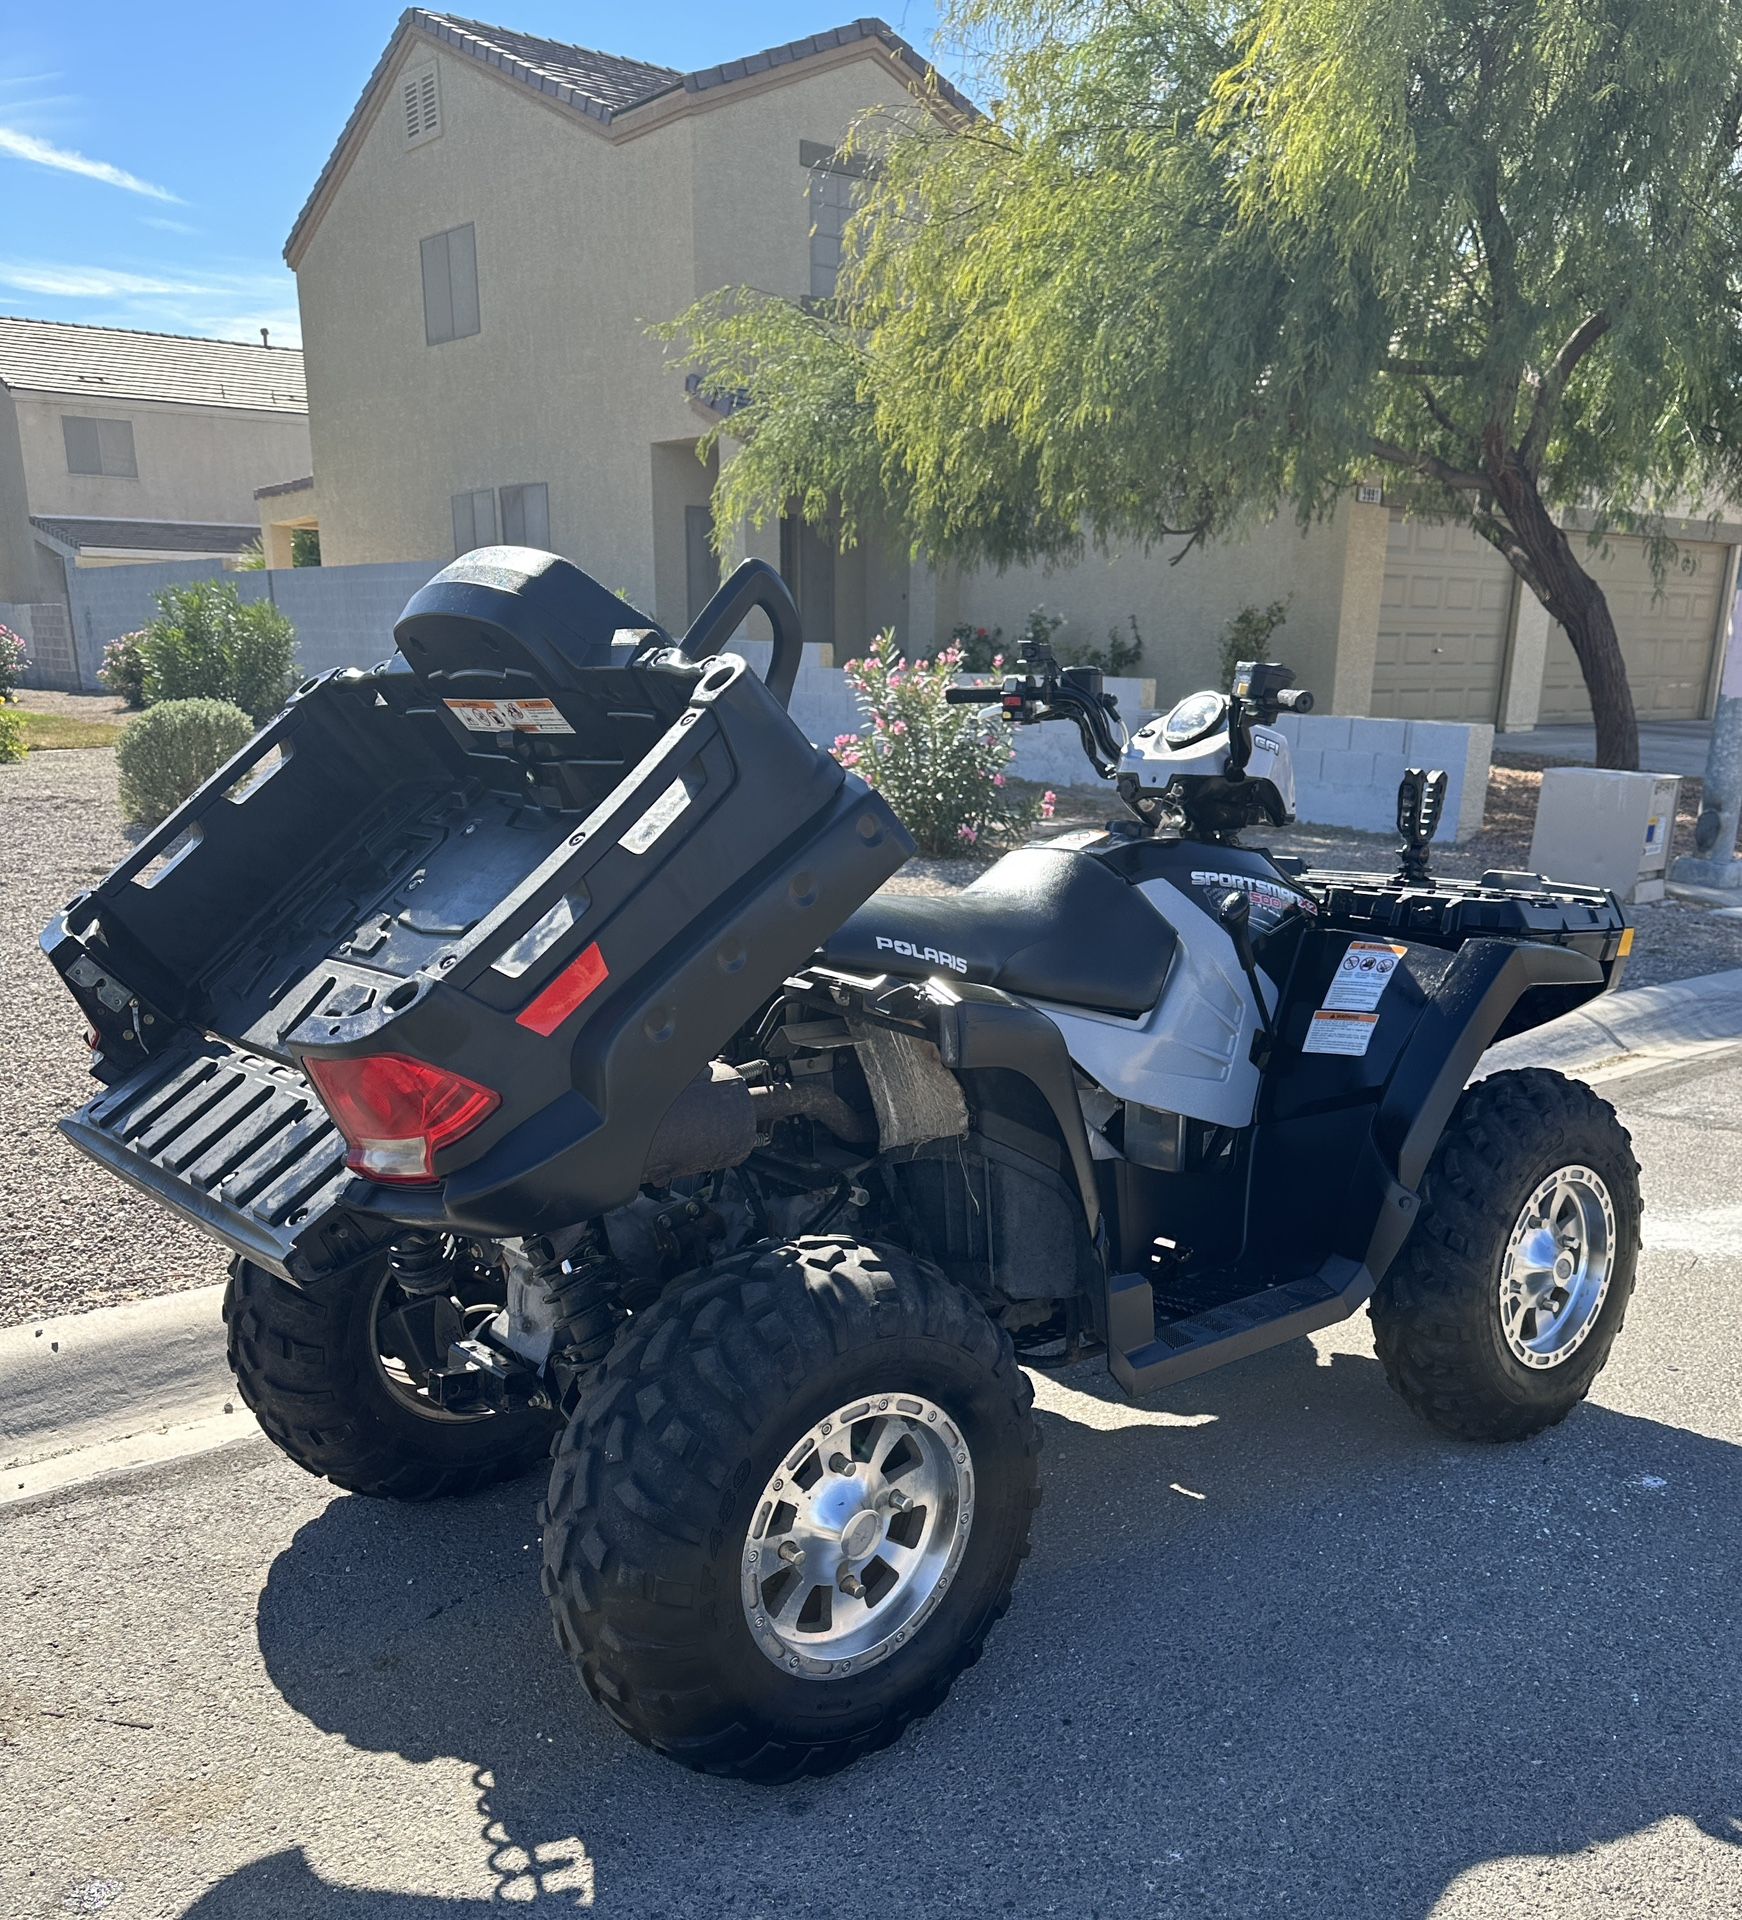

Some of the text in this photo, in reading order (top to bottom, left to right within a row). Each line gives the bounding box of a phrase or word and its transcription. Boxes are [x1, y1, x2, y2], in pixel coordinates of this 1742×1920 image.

[1190, 870, 1303, 904] SPORTSMAN
[1249, 891, 1282, 909] 500
[875, 936, 967, 974] POLARIS
